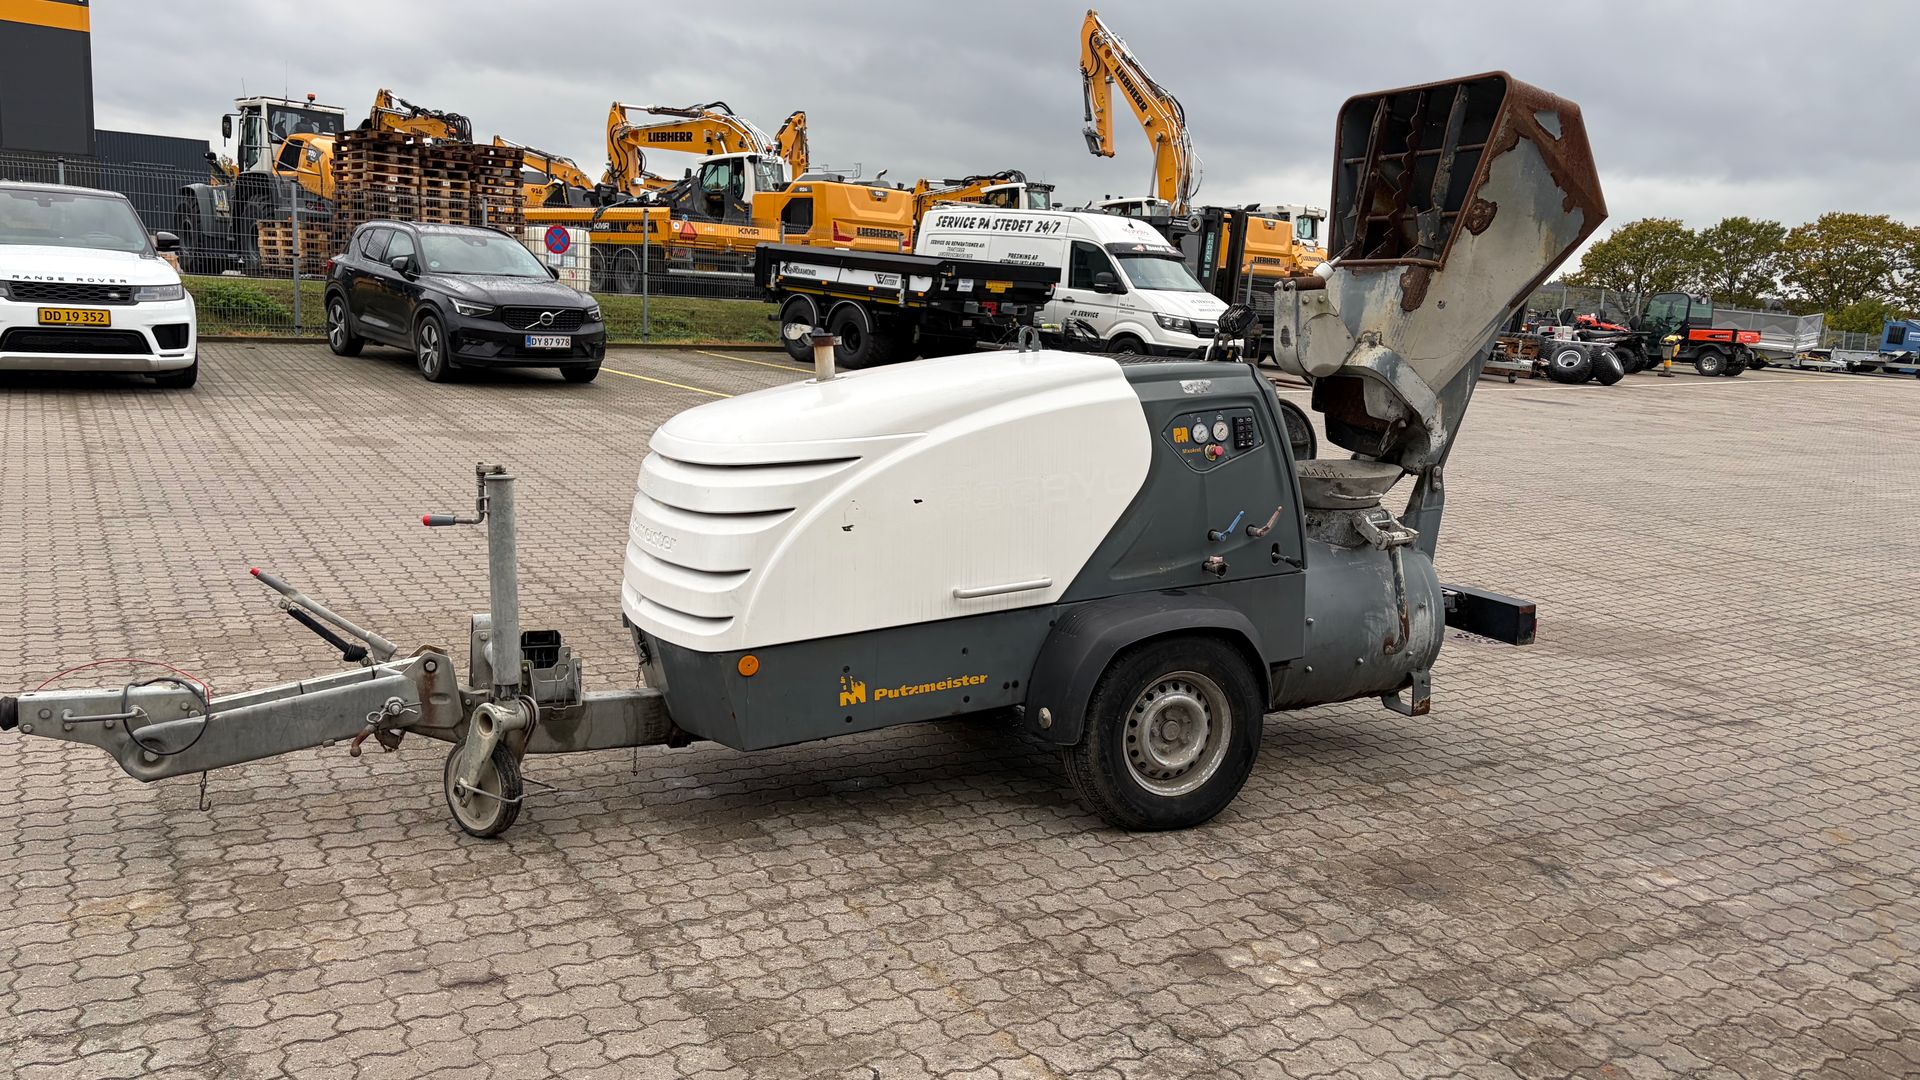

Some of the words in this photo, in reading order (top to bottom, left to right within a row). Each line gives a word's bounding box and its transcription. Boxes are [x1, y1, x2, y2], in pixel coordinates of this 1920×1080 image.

[1114, 65, 1148, 113] LIEBHERR
[648, 131, 693, 142] LIEBHERR
[936, 216, 976, 229] SERVICE
[978, 215, 991, 230] PÅ
[992, 218, 1033, 233] STEDET
[1035, 219, 1062, 235] 24/7
[738, 227, 760, 236] KMR
[857, 226, 899, 239] LIEBHERR
[45, 311, 61, 321] DD
[65, 311, 79, 322] 19
[82, 312, 105, 323] 352
[1078, 310, 1100, 319] SERVICE
[532, 337, 543, 346] DY
[544, 338, 553, 346] 87
[556, 338, 570, 347] 978
[874, 674, 988, 701] Putzmeister
